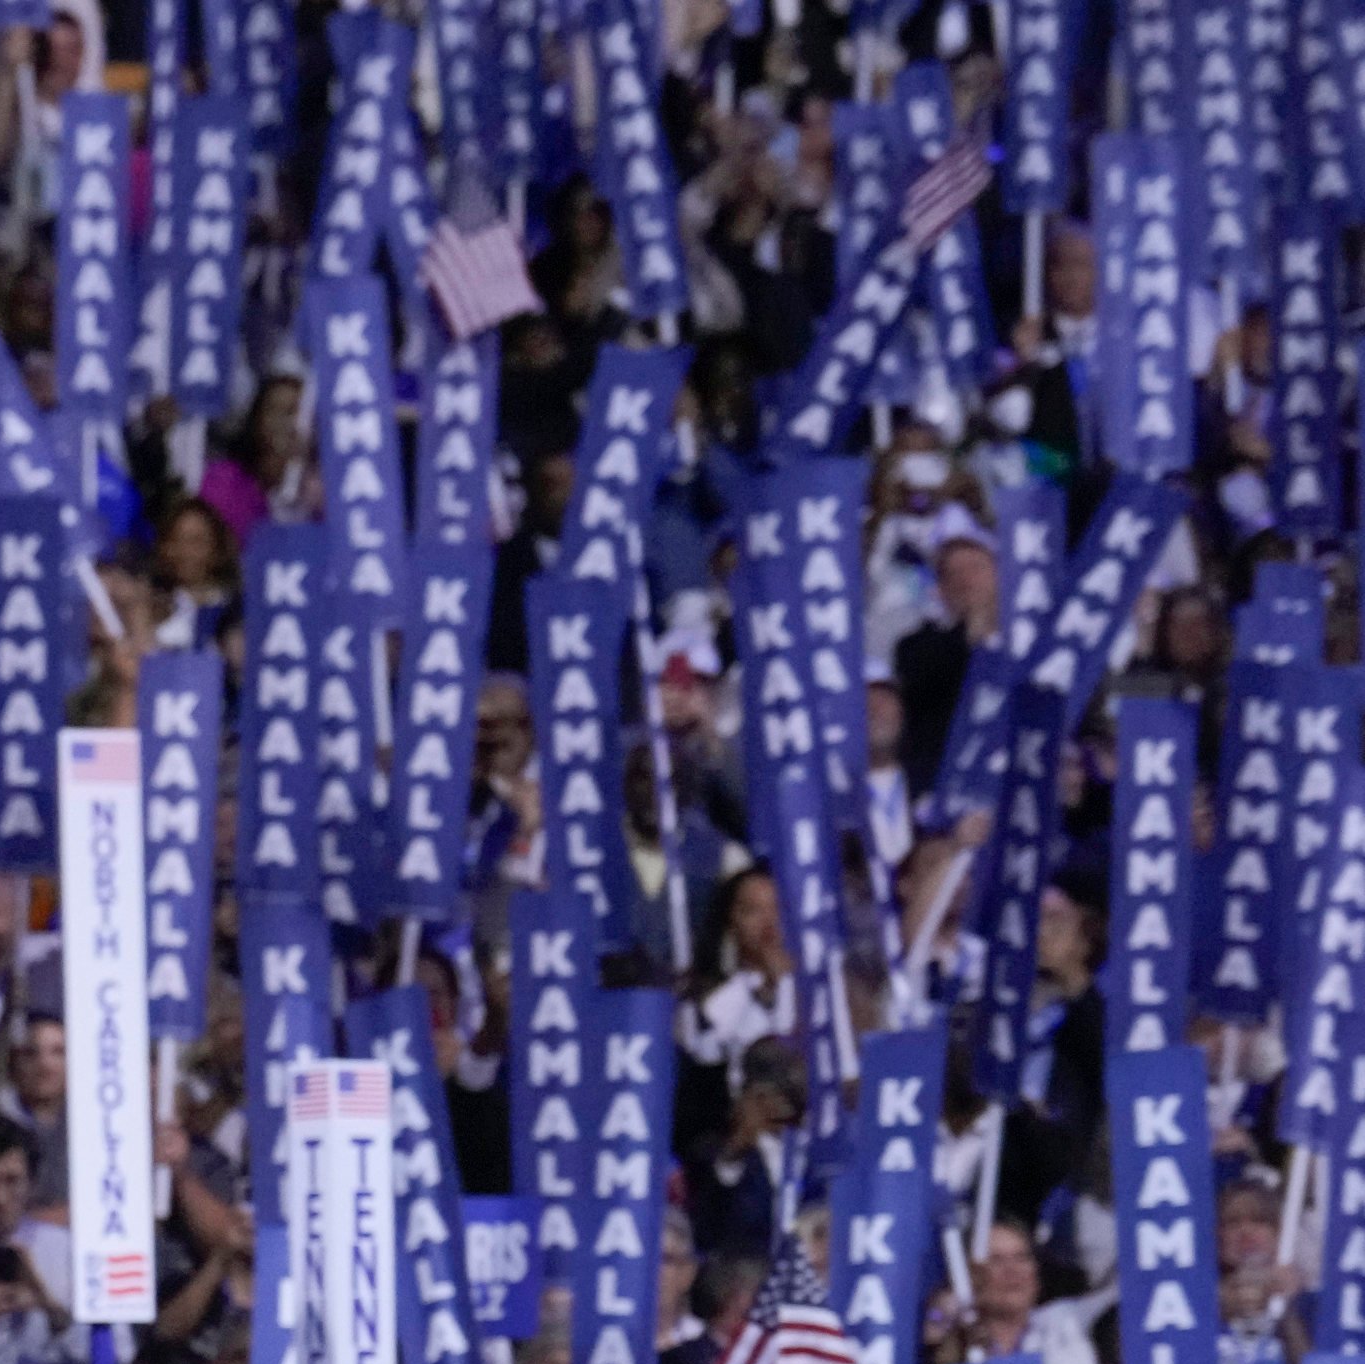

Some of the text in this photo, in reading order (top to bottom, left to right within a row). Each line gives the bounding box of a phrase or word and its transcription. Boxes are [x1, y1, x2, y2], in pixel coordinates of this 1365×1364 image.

[74, 122, 116, 394] KAMALA
[177, 127, 234, 386] KAMALA
[322, 55, 392, 277] KAMAL
[596, 22, 673, 282] KAMALA
[1193, 8, 1246, 248] KAMALA
[1130, 172, 1180, 441] KAMALA
[1282, 237, 1325, 508] KAMALA
[325, 310, 392, 595] KAMALA
[433, 347, 482, 540] AMAL
[573, 385, 653, 582] KAMA
[255, 560, 309, 868] KAMALA
[398, 573, 470, 884] KAMALA
[747, 600, 814, 758] KAM
[1032, 505, 1154, 694] KAMA
[148, 692, 201, 1000] KAMALA
[1123, 738, 1182, 1046] KAMALA
[1213, 703, 1278, 990] KAMALA
[528, 930, 580, 1250] KAMALA
